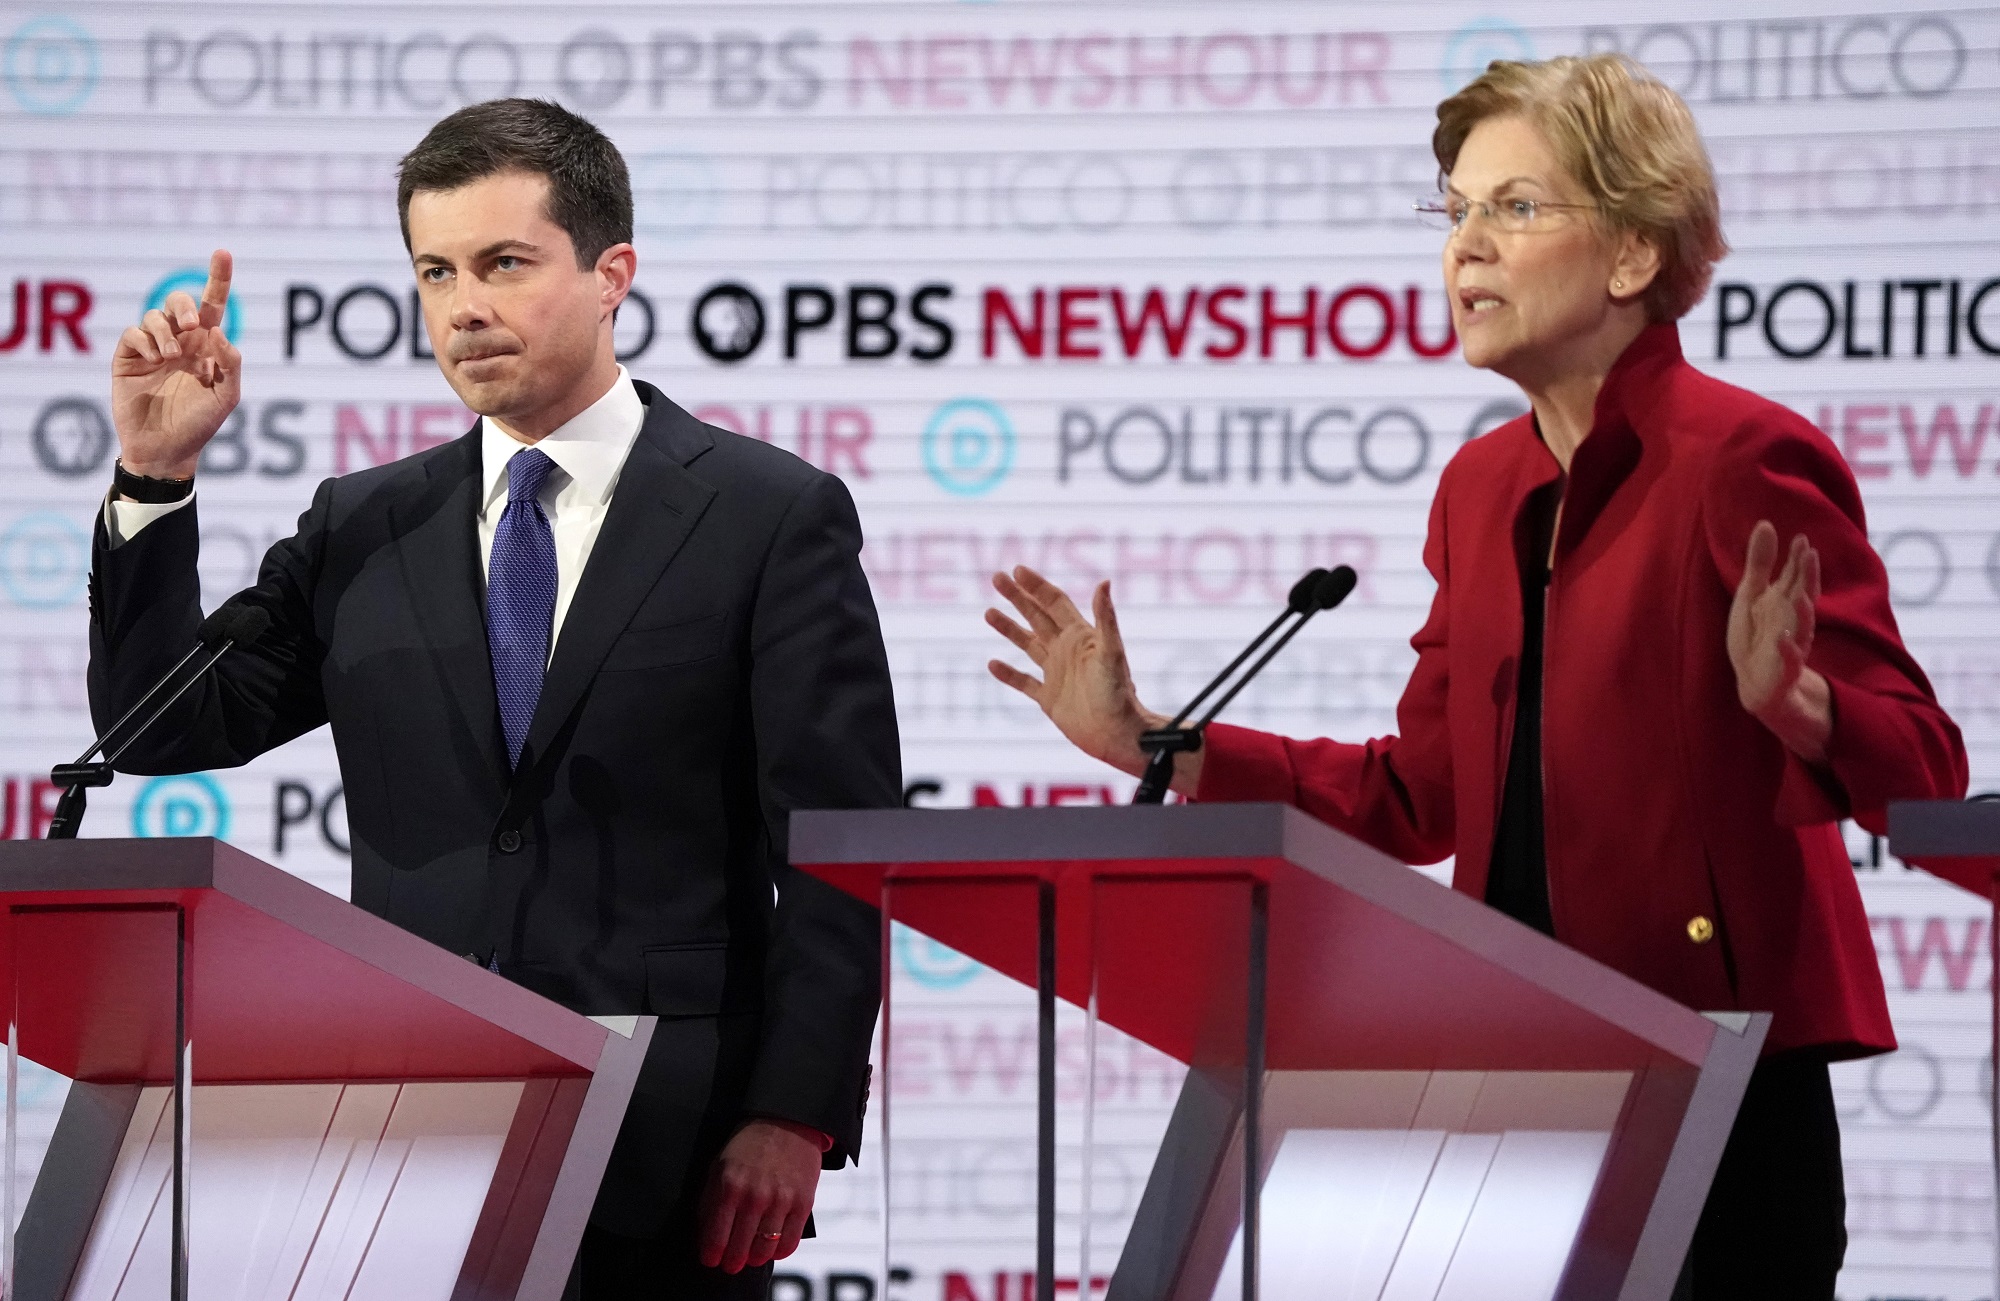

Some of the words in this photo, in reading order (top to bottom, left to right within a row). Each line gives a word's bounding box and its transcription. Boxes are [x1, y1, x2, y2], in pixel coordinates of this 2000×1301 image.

[143, 31, 521, 108] POLITICO
[650, 32, 823, 110] PBS
[846, 31, 1392, 109] NEWSHOUR
[26, 150, 398, 231] NEWSH
[783, 283, 955, 362] PBS
[981, 283, 1458, 360] NEWSHOU
[1716, 278, 2000, 360] POLITIC
[200, 399, 308, 477] BS
[1057, 405, 1430, 486] POLITICO
